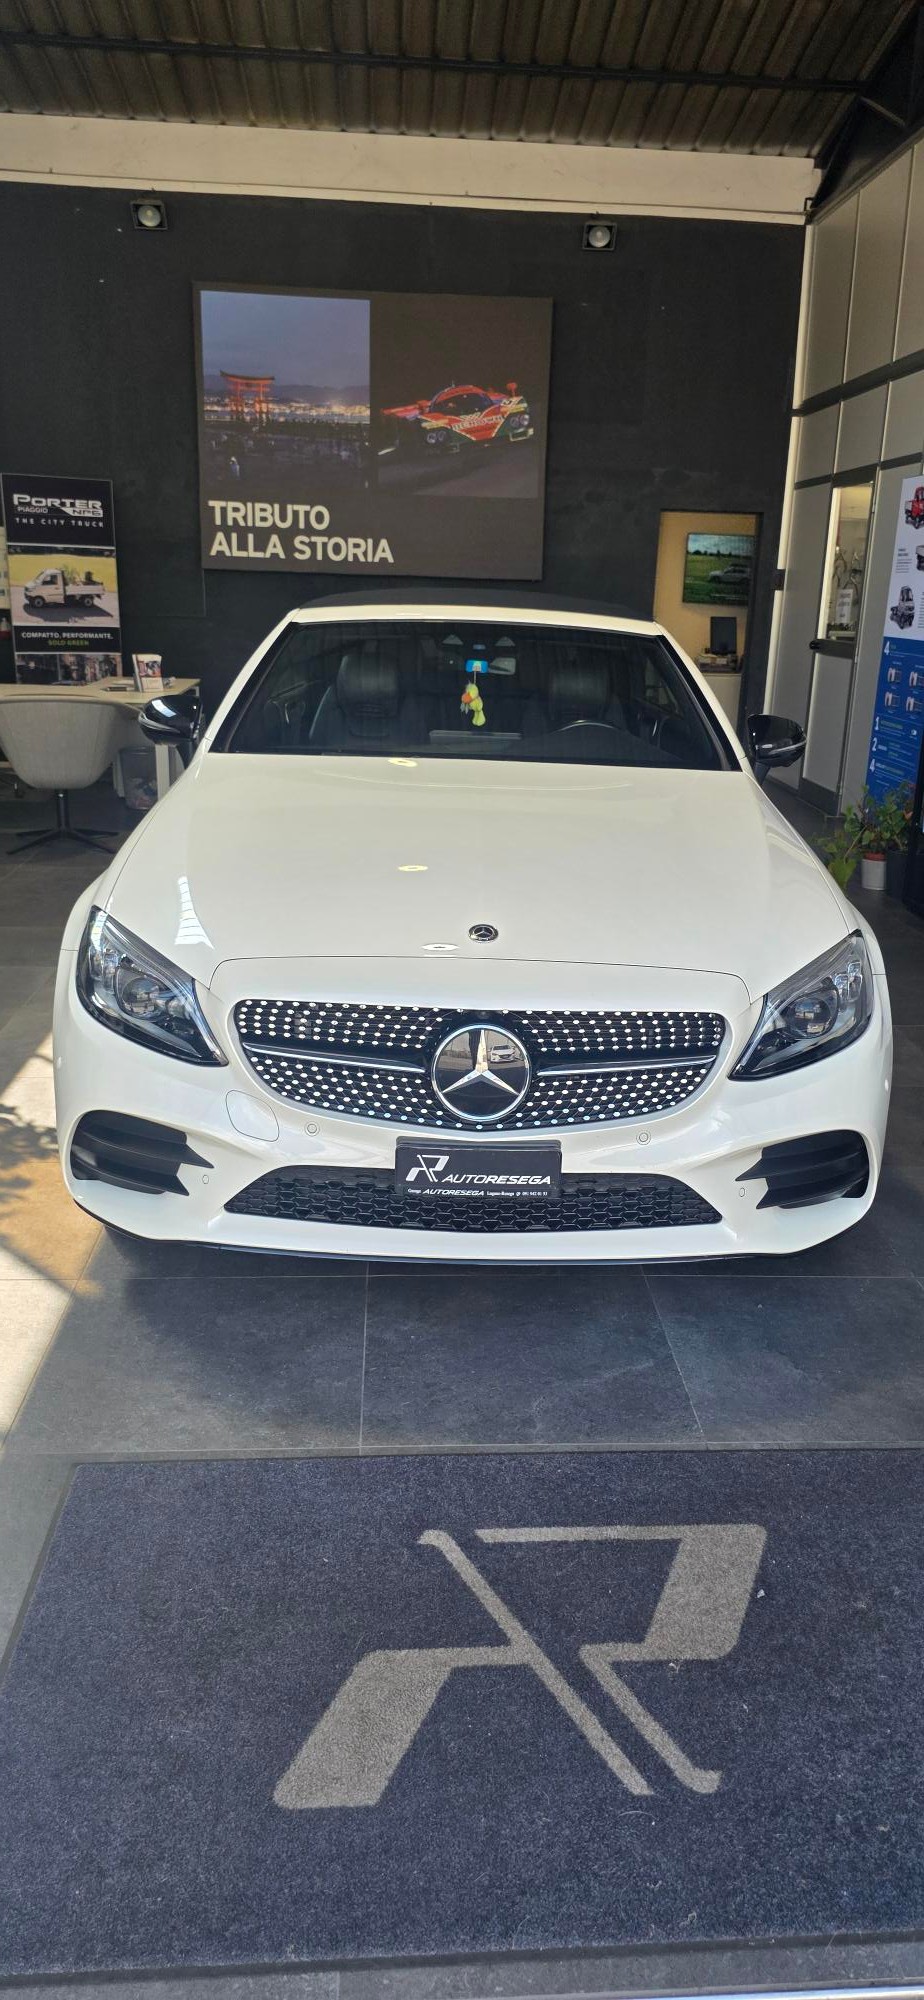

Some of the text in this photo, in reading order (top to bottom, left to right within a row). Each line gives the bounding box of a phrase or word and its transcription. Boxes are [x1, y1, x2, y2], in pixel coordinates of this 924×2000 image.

[12, 493, 103, 510] PORTER
[16, 506, 49, 514] PIAGGIO
[207, 500, 331, 531] TRIBUTO
[15, 517, 104, 528] THE CITY TRUCK
[209, 531, 395, 564] ALLA STORIA
[883, 640, 890, 656] 4
[871, 737, 878, 752] 2
[441, 1174, 551, 1185] AUTORESEGA
[422, 1188, 485, 1196] AUTORESEGA
